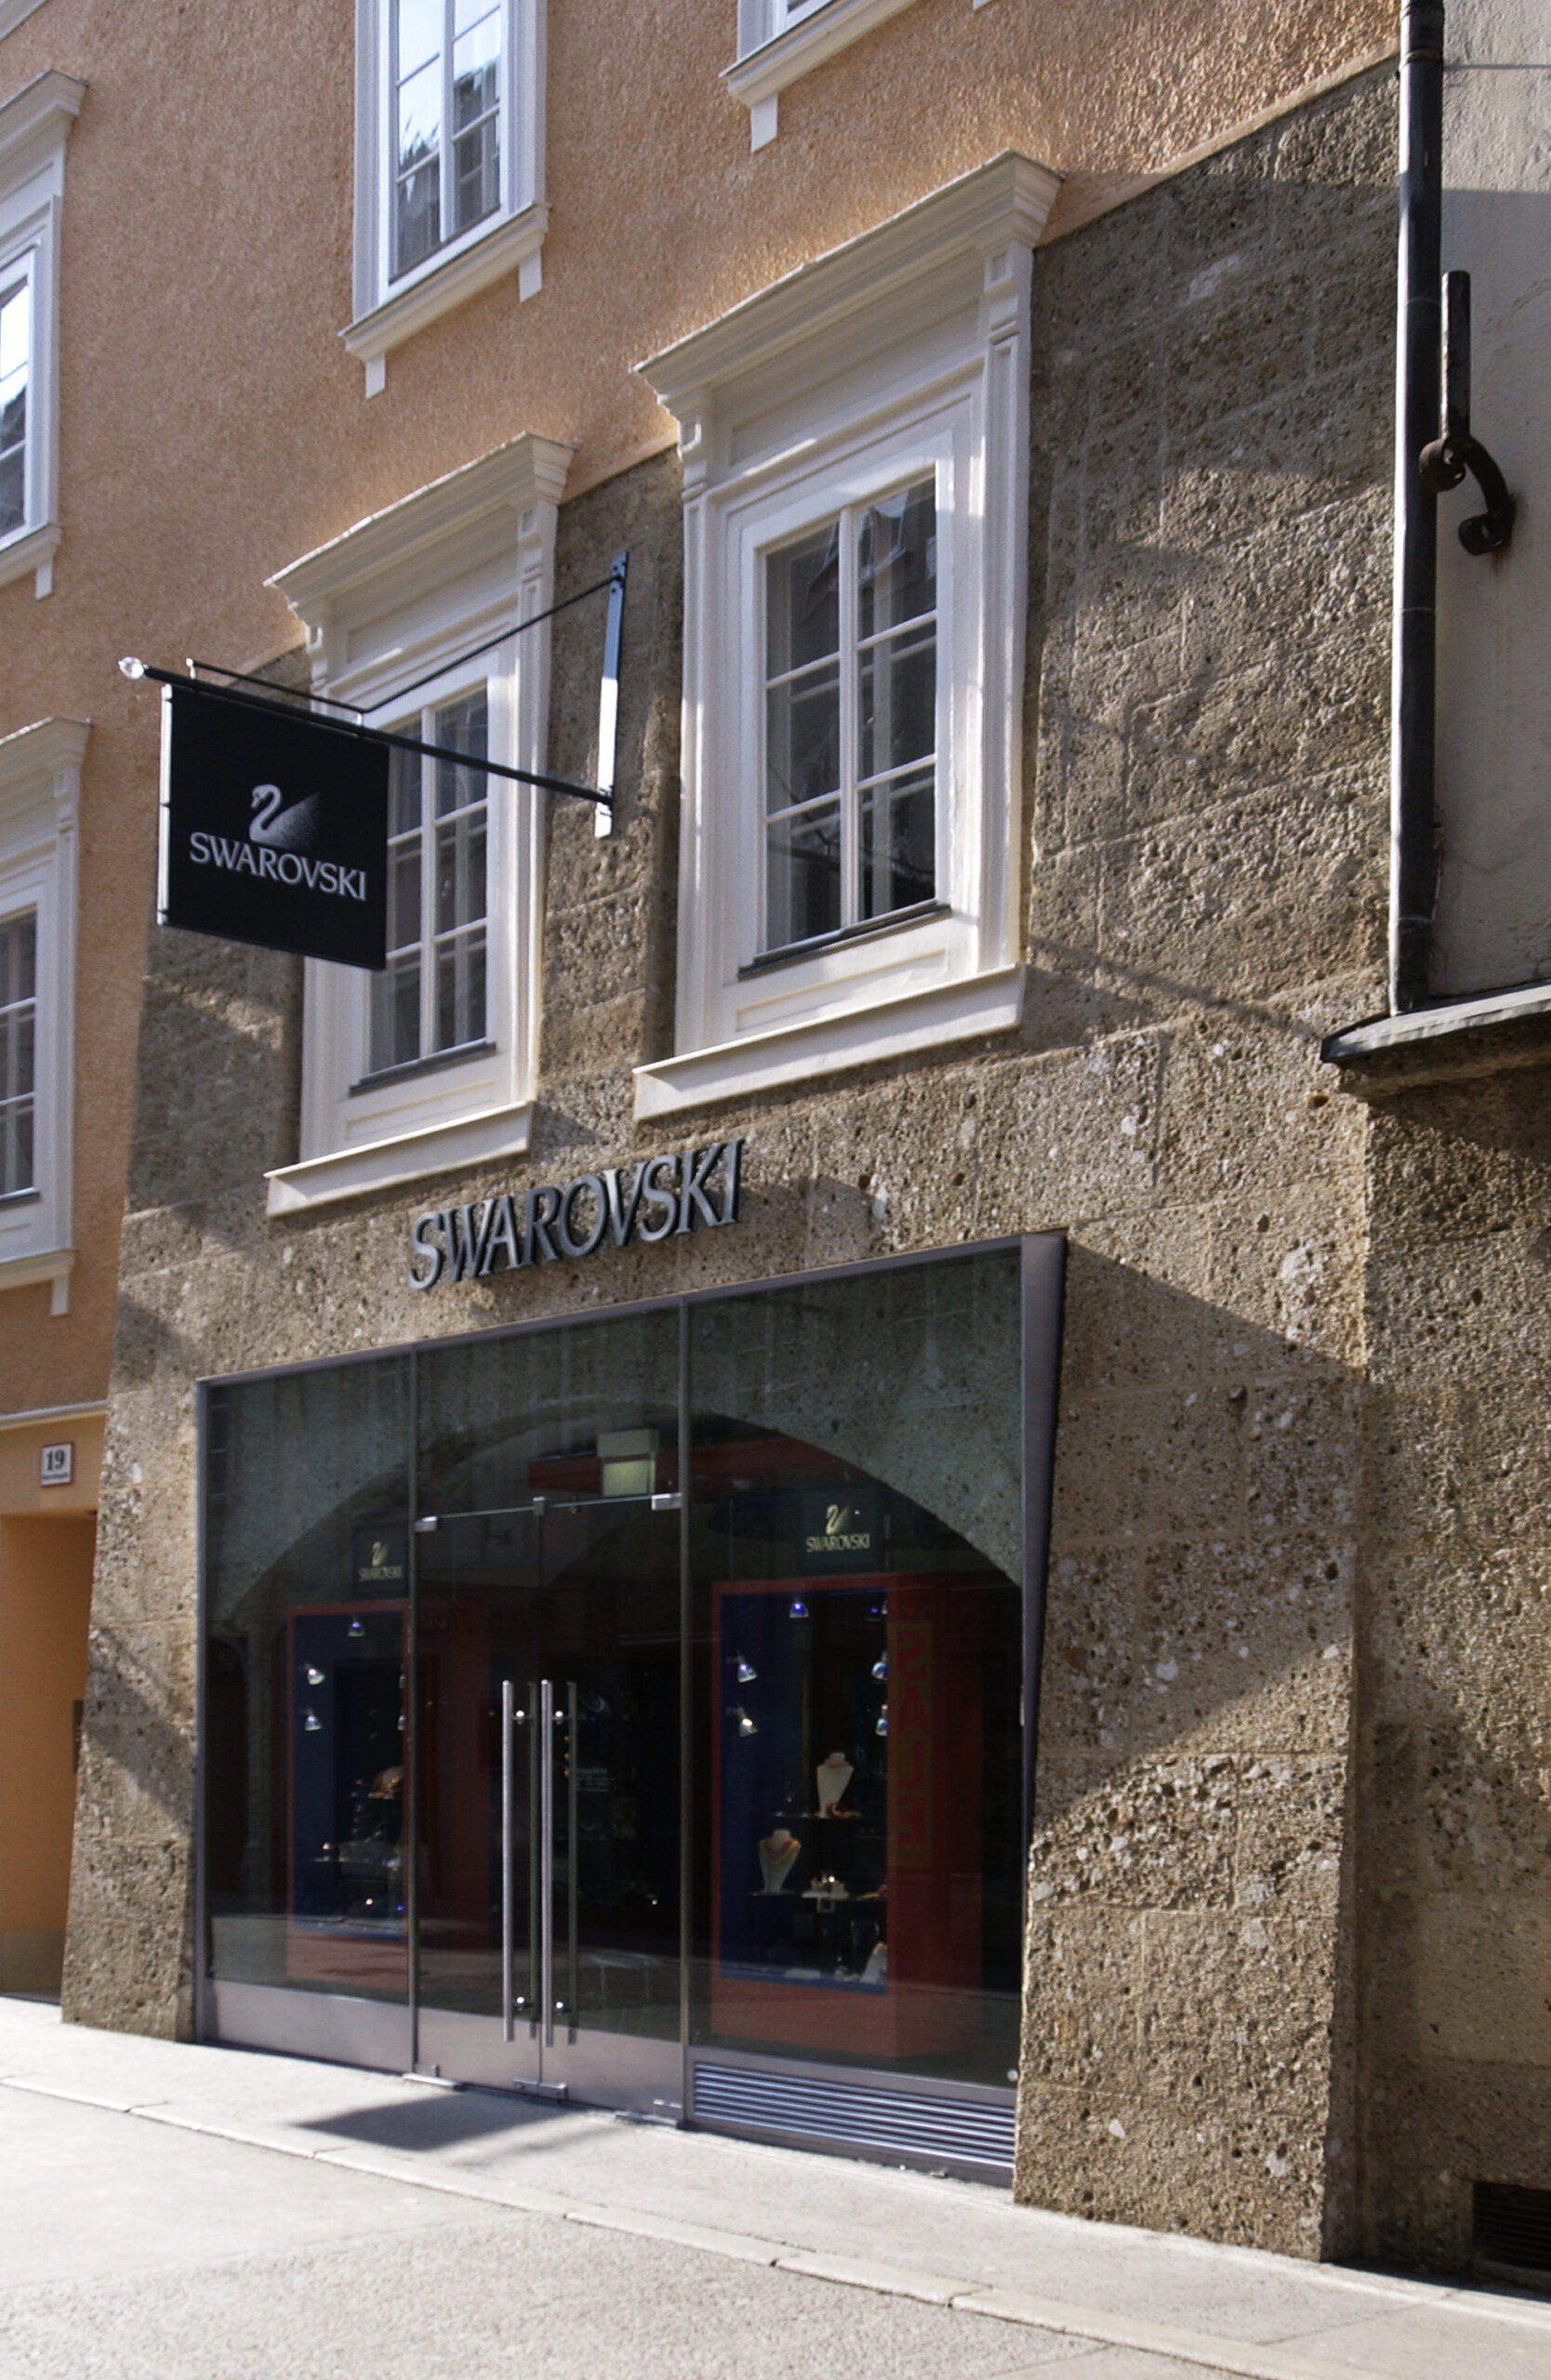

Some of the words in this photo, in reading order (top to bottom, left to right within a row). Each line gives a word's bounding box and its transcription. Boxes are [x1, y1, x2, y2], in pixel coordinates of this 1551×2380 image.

[190, 831, 366, 901] SWAROVSKI
[408, 1138, 744, 1290] SWAROVSKI
[46, 1448, 65, 1472] 19
